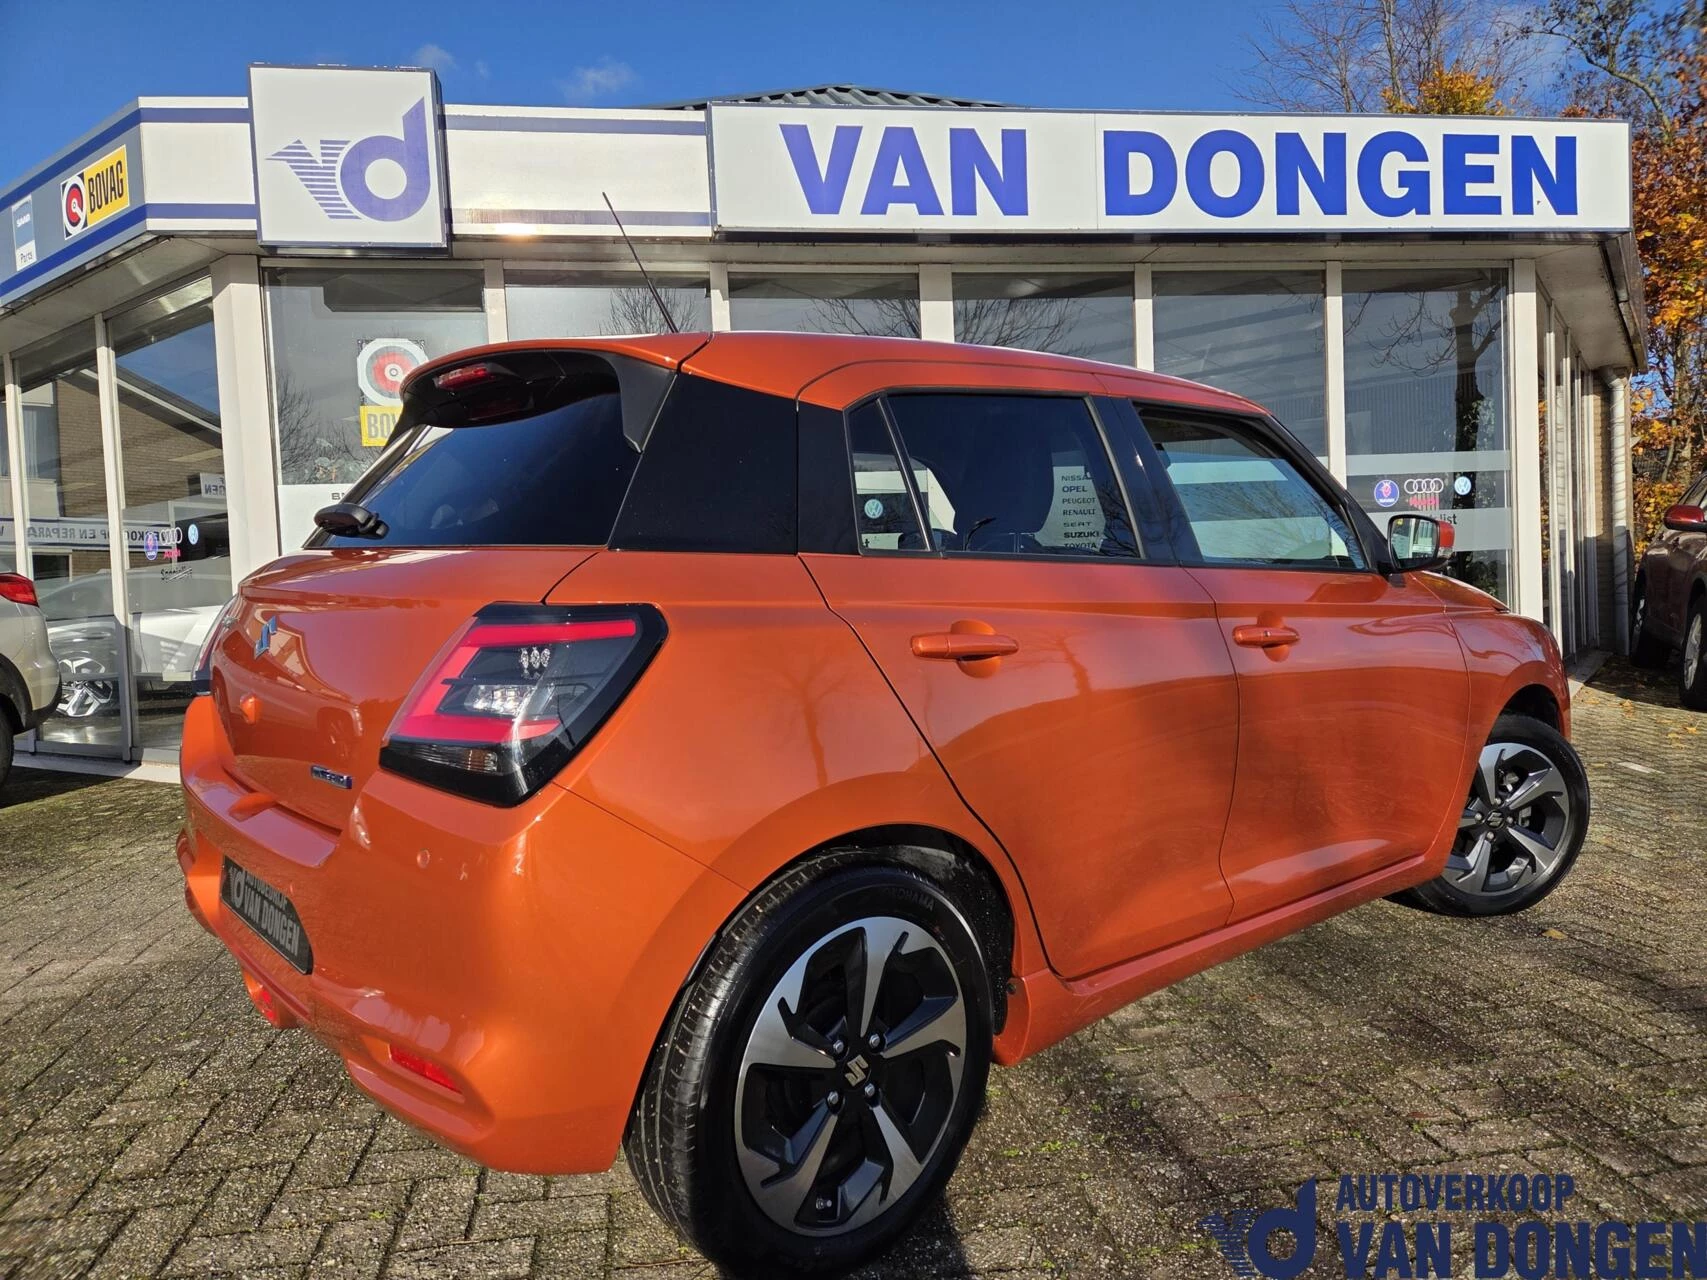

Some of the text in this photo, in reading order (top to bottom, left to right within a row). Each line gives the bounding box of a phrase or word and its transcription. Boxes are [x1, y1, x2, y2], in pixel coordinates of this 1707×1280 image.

[87, 159, 124, 214] BOVAG
[779, 124, 1578, 218] VAN DONGEN
[1062, 485, 1088, 493] OPEL
[1062, 508, 1096, 516] RENAULT
[1063, 531, 1099, 539] SUZUKI
[243, 885, 261, 923] VAN
[260, 899, 300, 957] DONGEN
